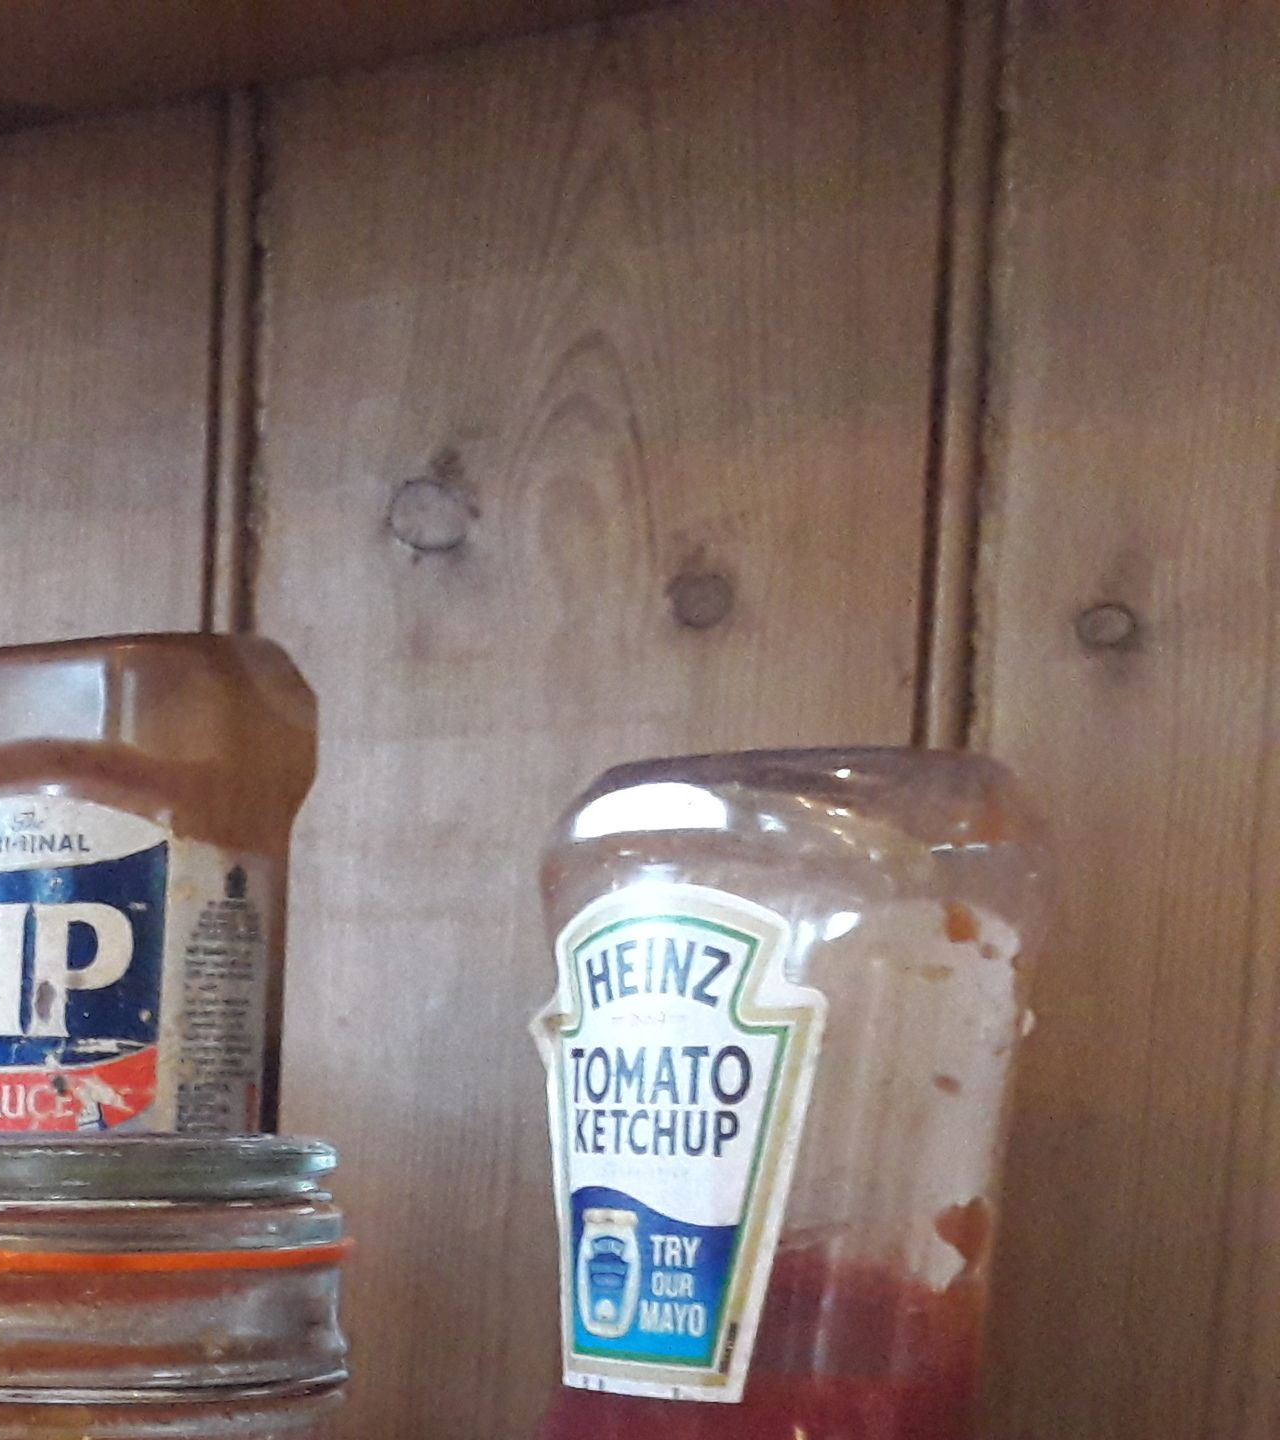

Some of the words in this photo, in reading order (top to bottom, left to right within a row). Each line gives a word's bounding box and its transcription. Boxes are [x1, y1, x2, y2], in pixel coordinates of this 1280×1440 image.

[586, 937, 731, 1009] HEINZ
[570, 1045, 752, 1105] TOMATO
[574, 1109, 739, 1157] KETCHUP
[649, 1234, 702, 1268] TRY
[651, 1271, 694, 1298] OUR
[639, 1299, 707, 1337] MAYO
